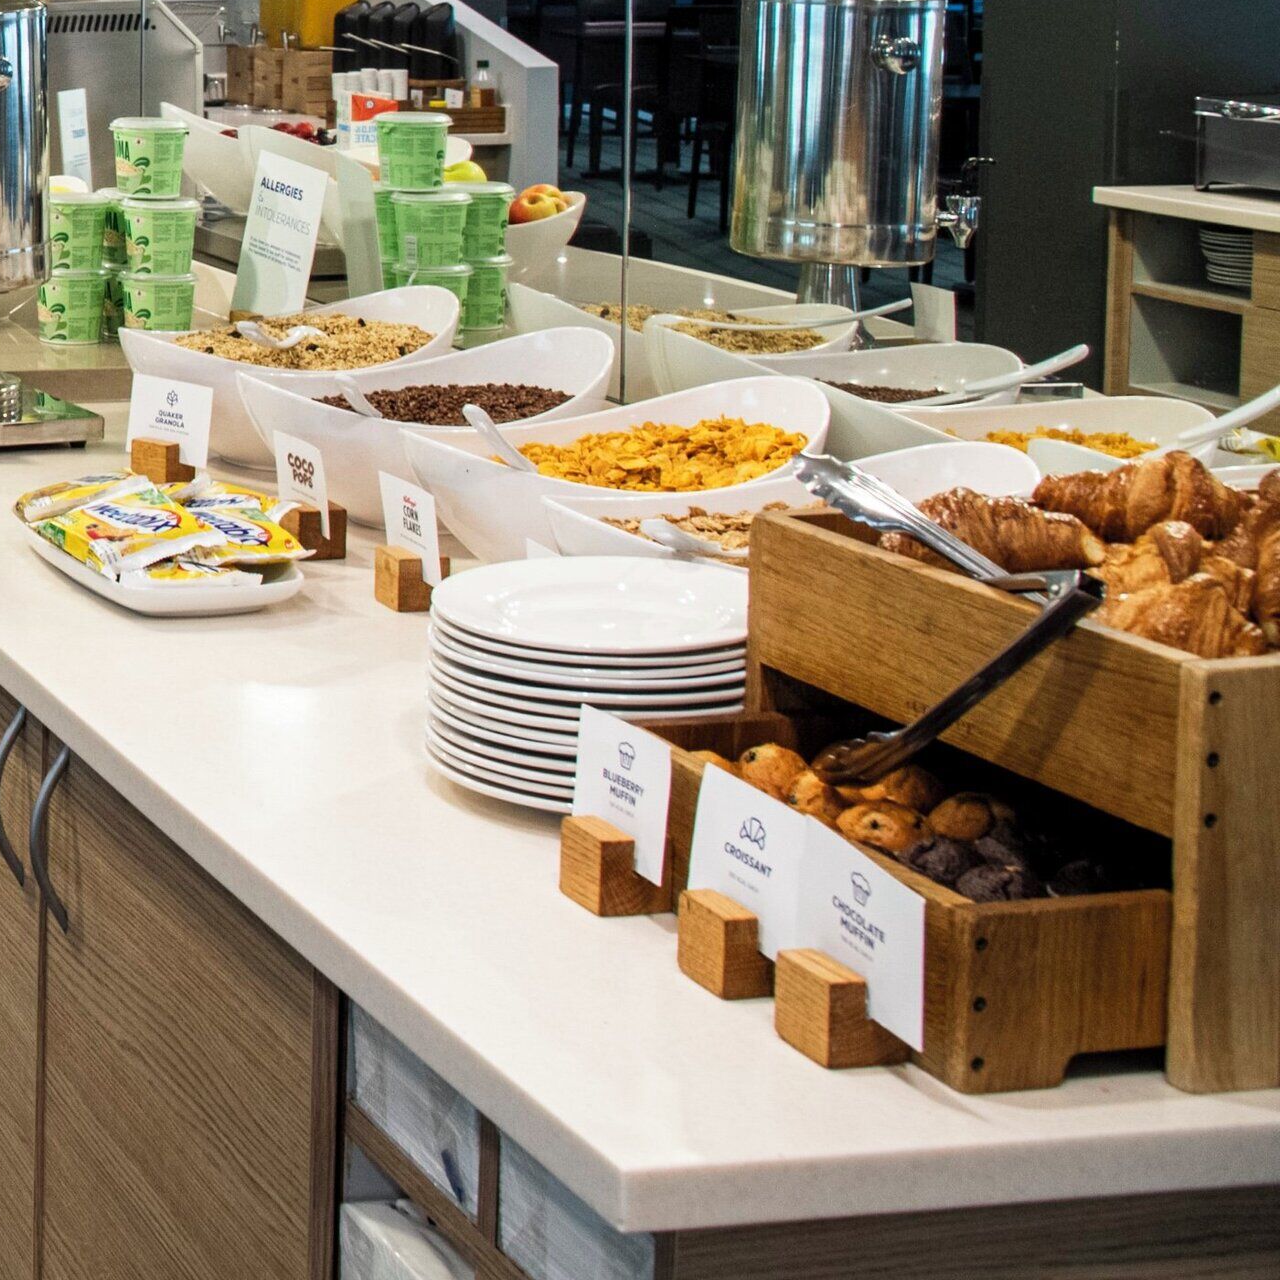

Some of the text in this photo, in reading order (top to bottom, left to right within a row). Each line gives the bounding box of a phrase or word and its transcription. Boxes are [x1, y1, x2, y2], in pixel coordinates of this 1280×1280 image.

[260, 177, 304, 201] ALLERGIES
[255, 205, 312, 236] INTOLERANCES
[154, 416, 185, 429] GRANOLA
[158, 409, 184, 420] QUAKER
[287, 452, 315, 477] COCO
[292, 468, 314, 489] POPS
[402, 505, 419, 522] CORN
[402, 516, 422, 537] FLAKES
[602, 767, 645, 798] BLUEBERRY
[609, 784, 637, 807] MUFFIN
[723, 841, 773, 878] CROISSANT
[832, 894, 886, 945] CHOCOLATE
[840, 916, 875, 951] MUFFIN
